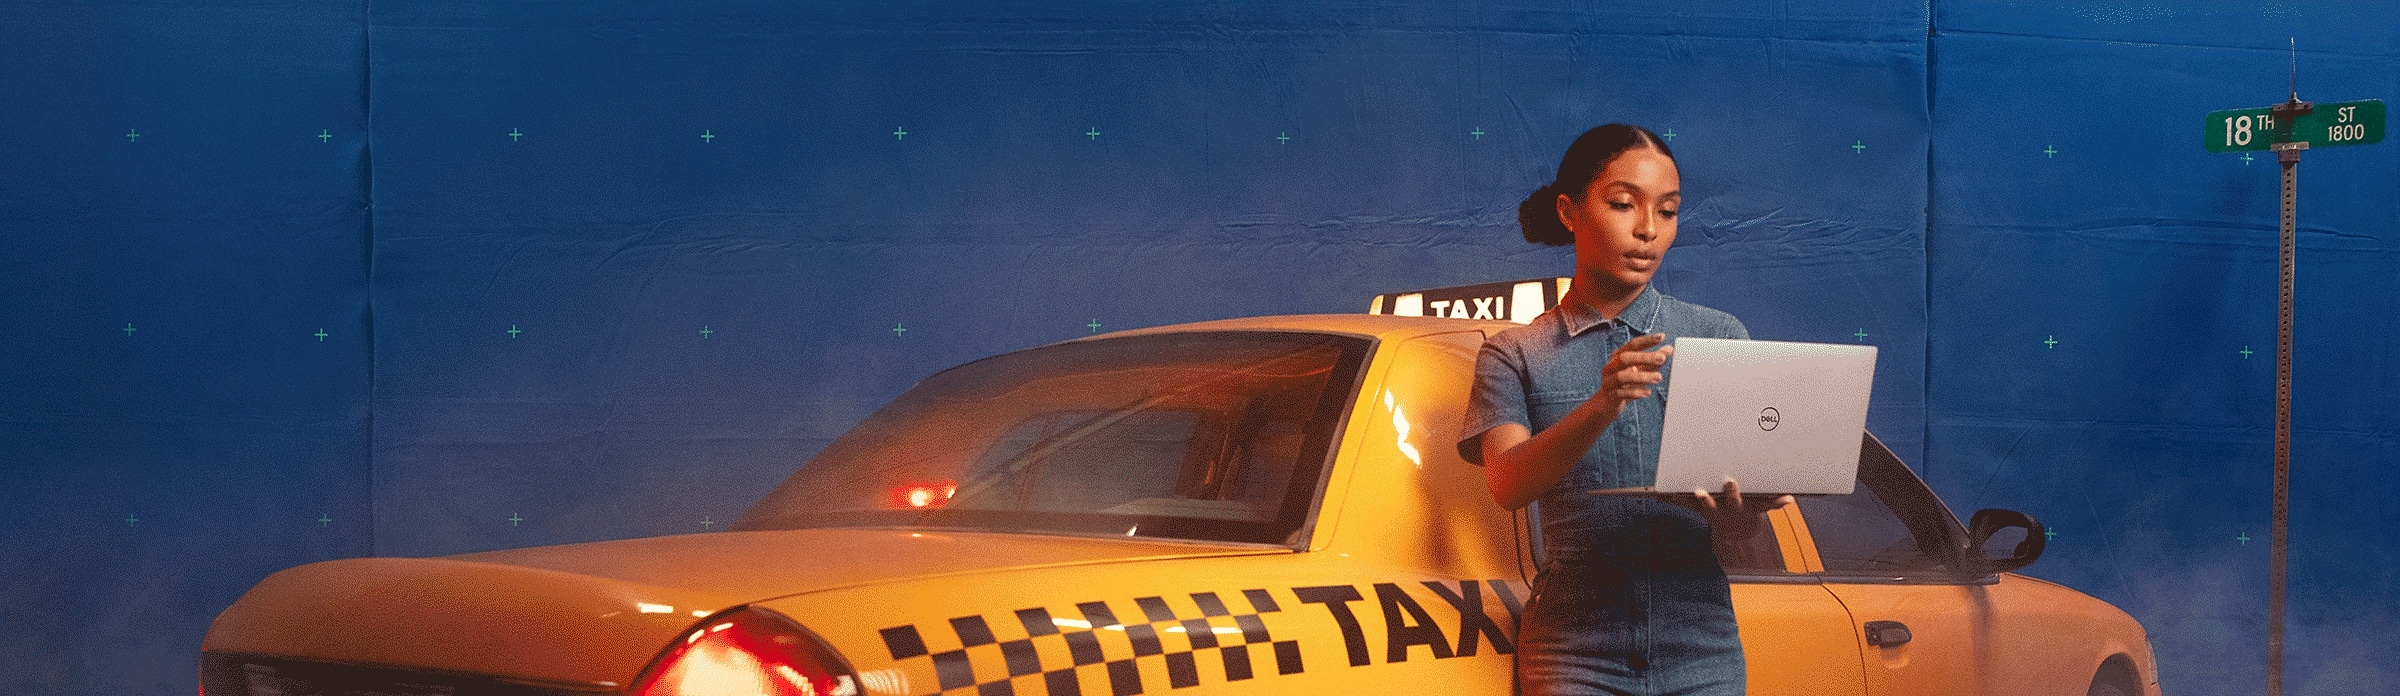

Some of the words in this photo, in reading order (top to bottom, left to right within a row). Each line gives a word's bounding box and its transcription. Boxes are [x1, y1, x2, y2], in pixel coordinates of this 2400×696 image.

[2337, 106, 2356, 123] ST
[2328, 123, 2365, 142] 1800
[1430, 296, 1504, 320] TAXI
